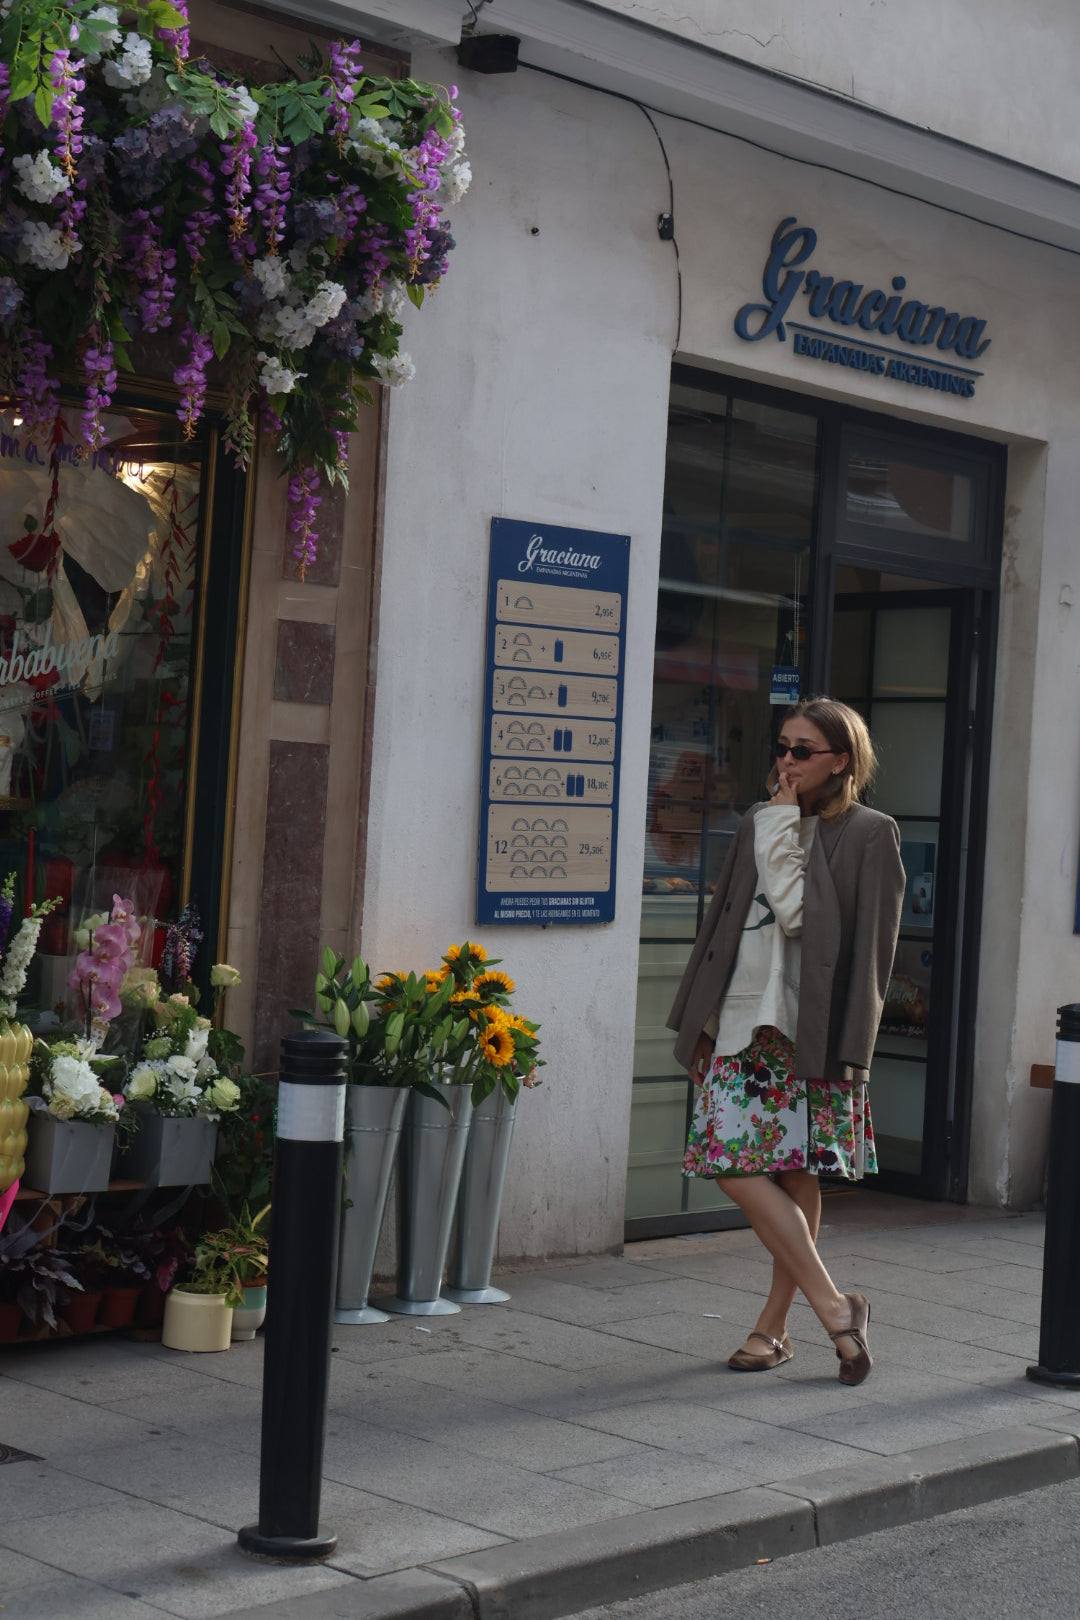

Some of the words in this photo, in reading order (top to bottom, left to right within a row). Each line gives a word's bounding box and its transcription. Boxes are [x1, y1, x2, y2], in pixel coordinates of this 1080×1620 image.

[734, 216, 992, 359] Graciana
[793, 333, 885, 376] EMPANADAS
[884, 359, 976, 398] ARGENTINAS
[518, 534, 602, 572] Graciana
[536, 566, 562, 576] EMPANADAS
[562, 569, 588, 579] ARGENTINAS
[595, 605, 614, 618] 2,95€
[502, 639, 507, 649] 2
[593, 648, 612, 661] 6,95€
[772, 673, 800, 683] ABIERTO
[31, 687, 58, 700] COFFEE
[500, 685, 505, 695] 3
[498, 730, 503, 741] 4
[496, 776, 501, 786] 6
[495, 840, 508, 854] 12
